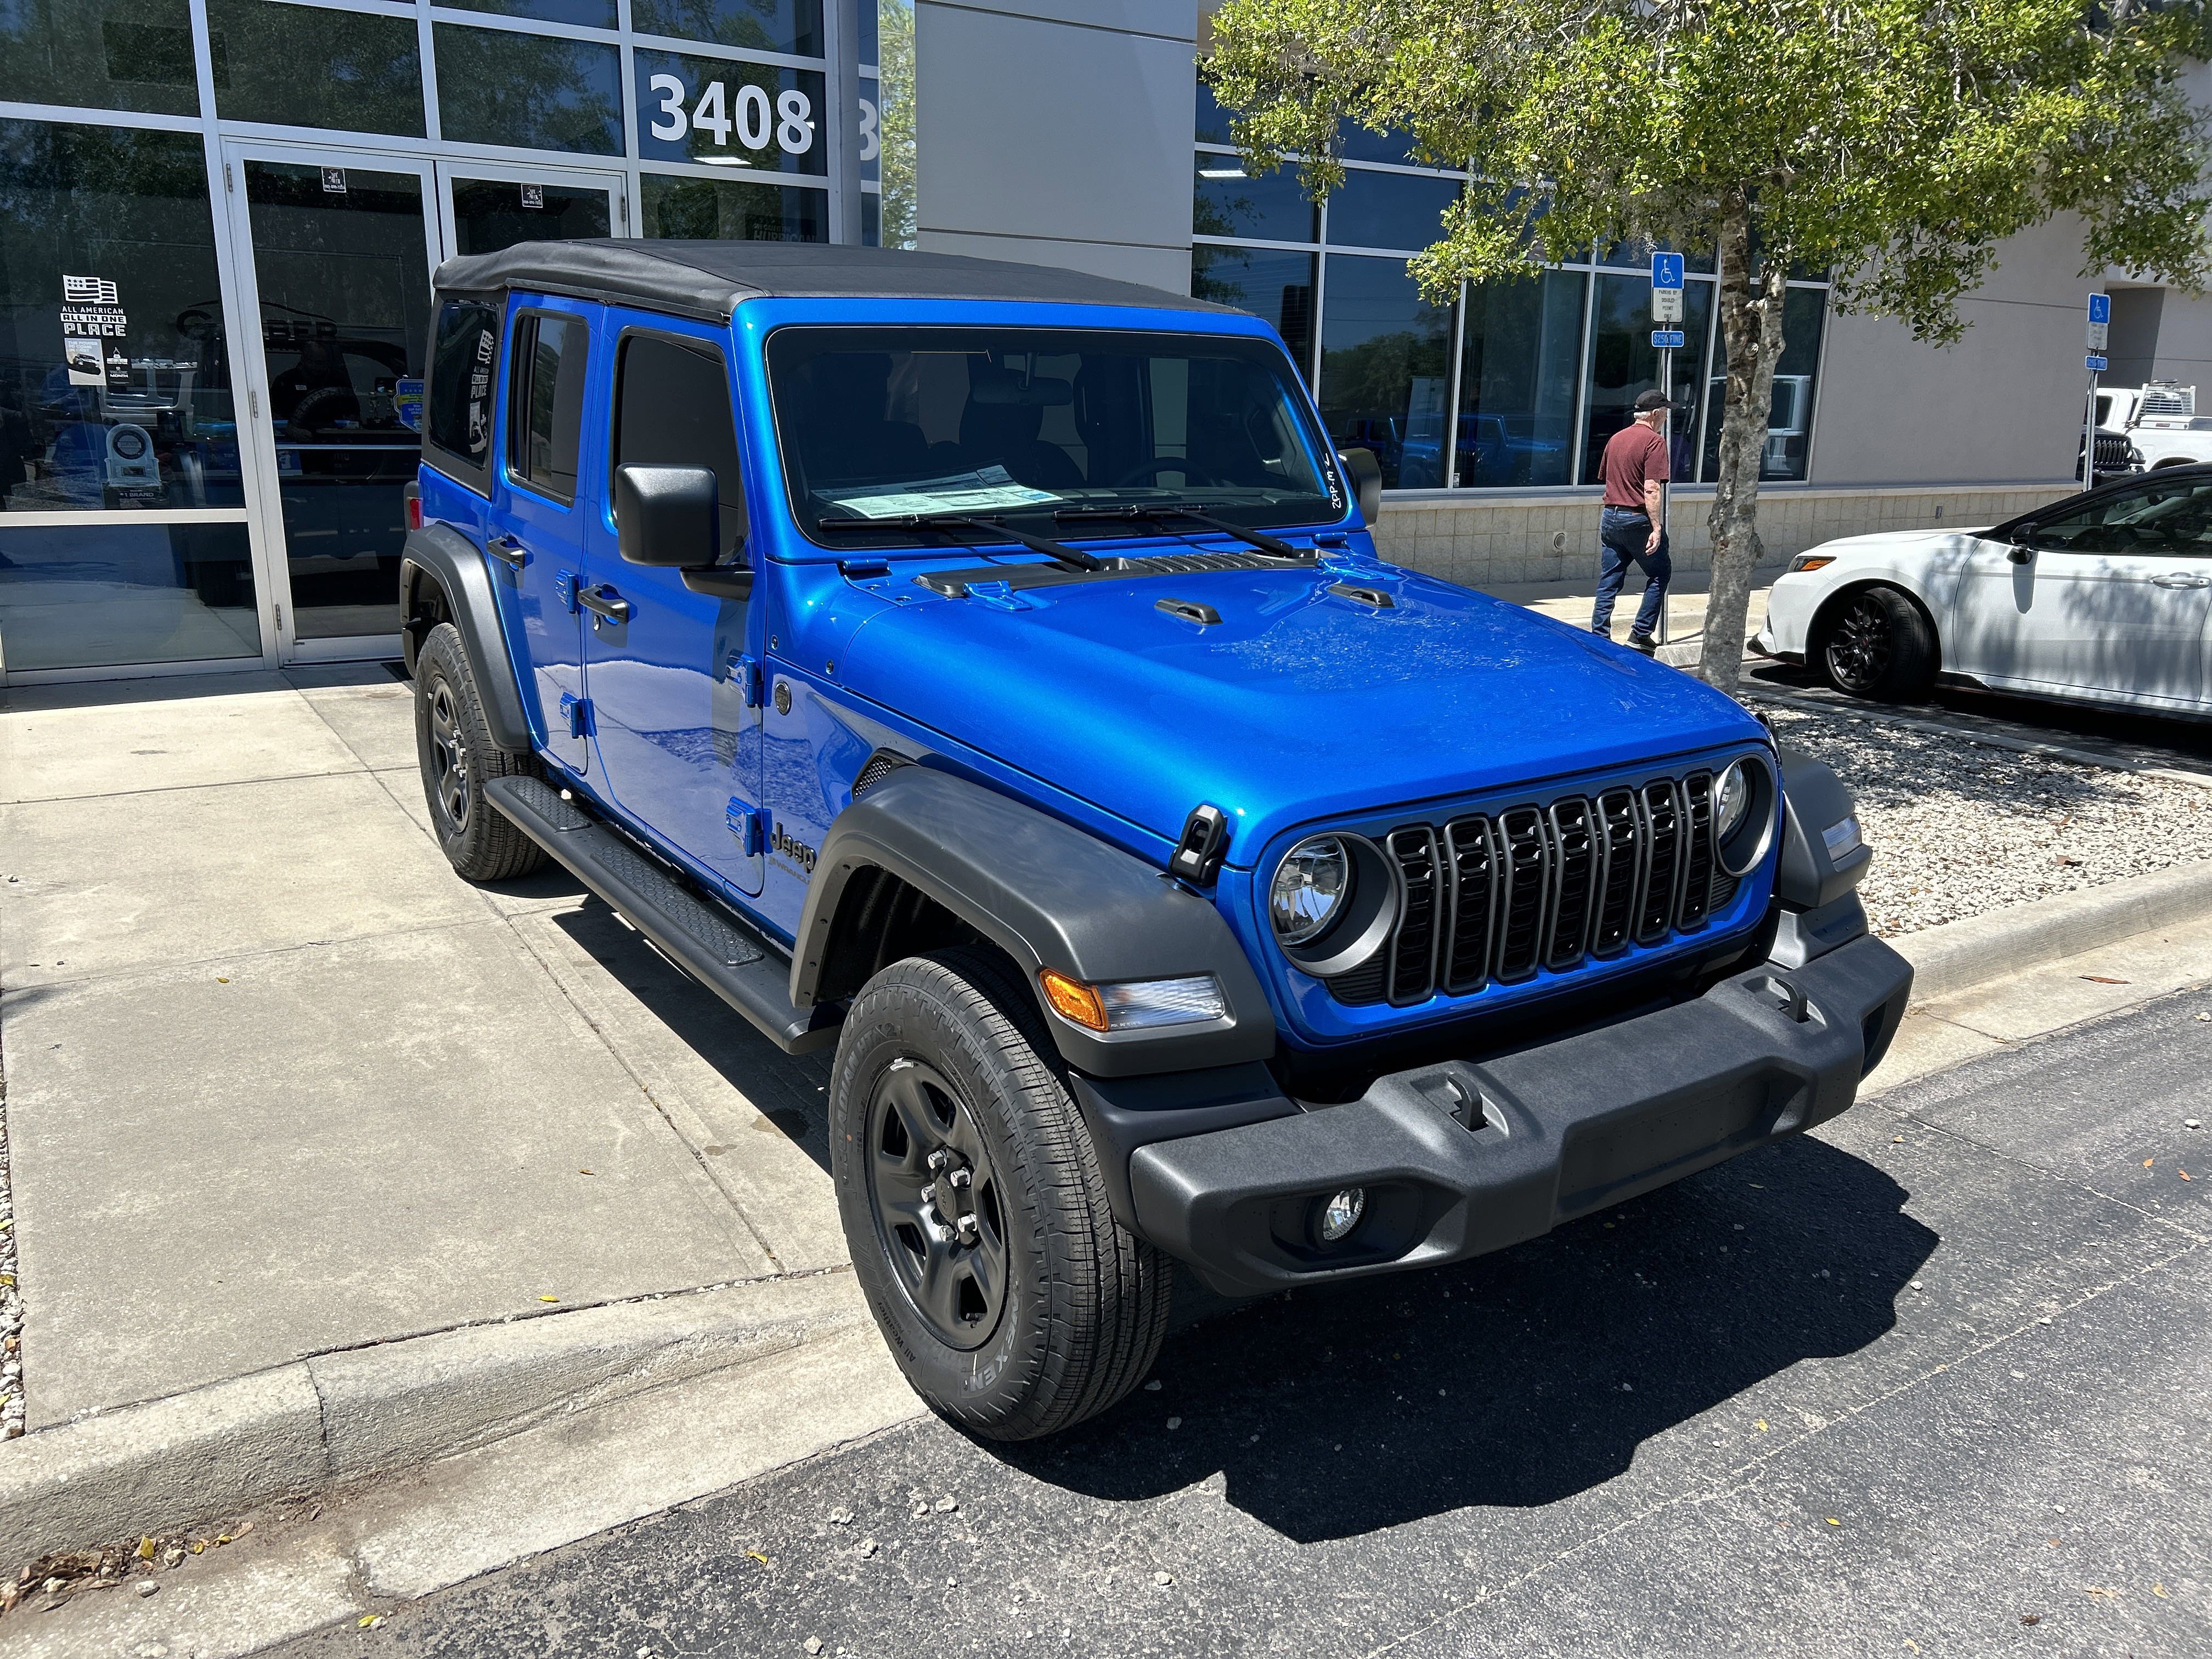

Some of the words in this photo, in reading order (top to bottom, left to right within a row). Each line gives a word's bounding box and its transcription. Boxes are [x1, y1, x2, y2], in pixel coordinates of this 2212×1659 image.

[650, 74, 812, 154] 3408
[64, 323, 126, 336] PLACE
[1669, 334, 1682, 343] FINE
[769, 822, 817, 874] Jeep
[776, 860, 811, 885] WRANGL
[968, 1290, 1019, 1392] NEXEN
